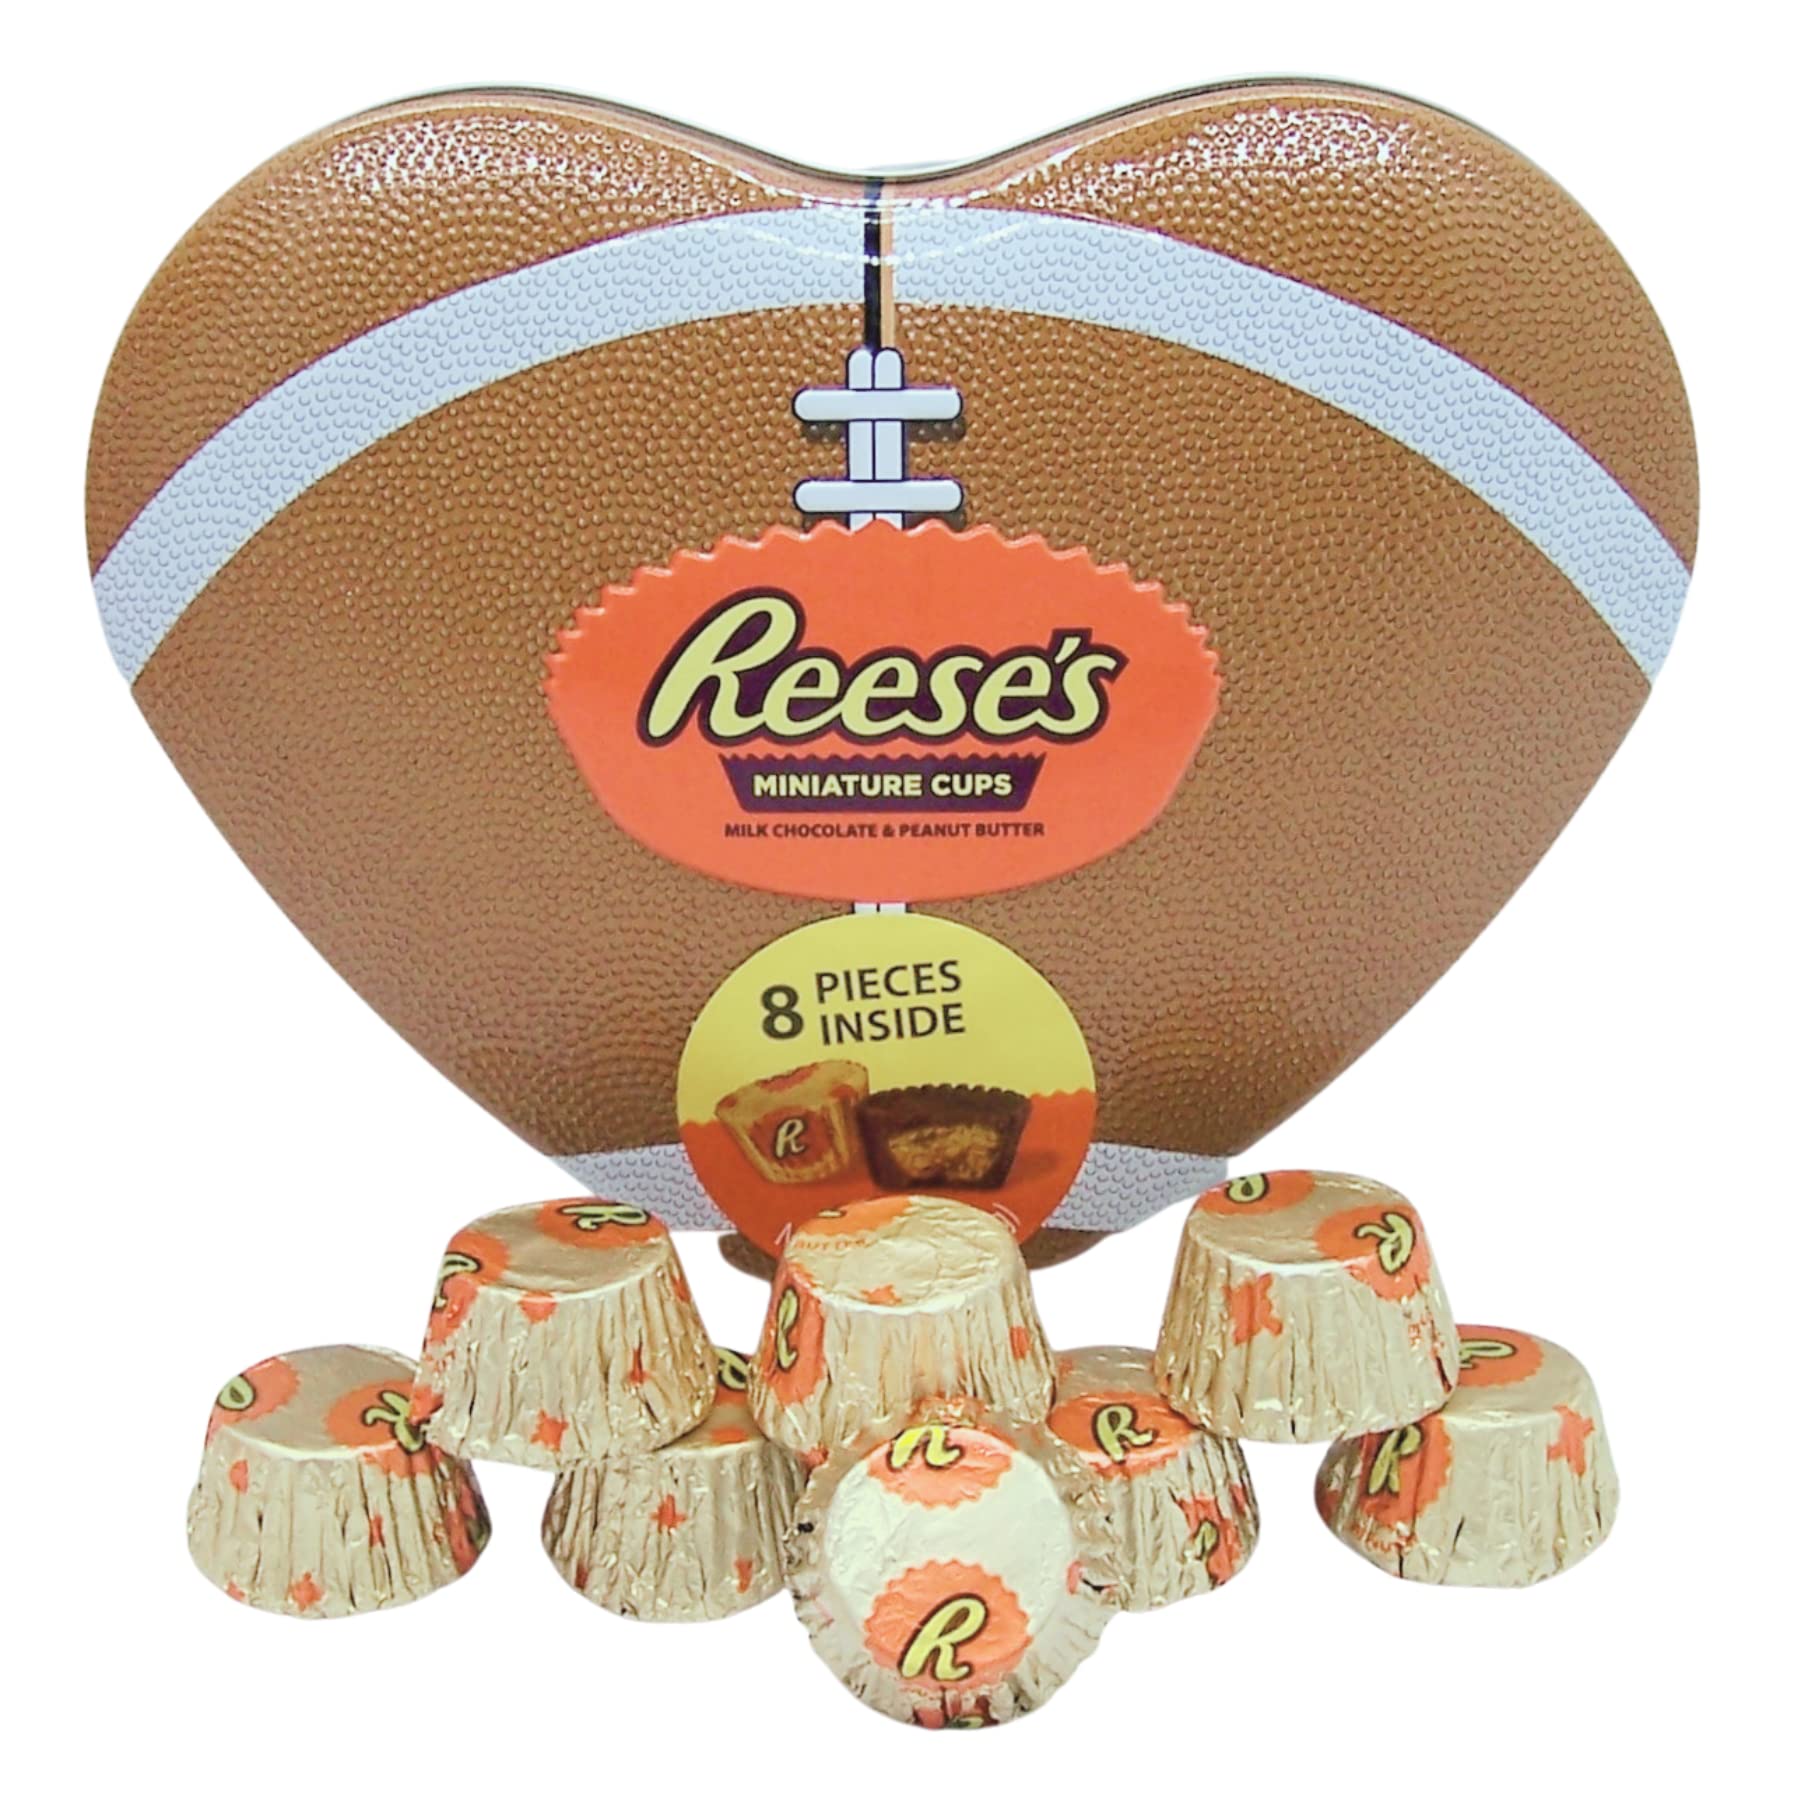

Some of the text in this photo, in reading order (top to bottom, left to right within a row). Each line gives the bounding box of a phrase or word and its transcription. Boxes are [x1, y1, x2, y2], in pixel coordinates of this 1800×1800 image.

[752, 772, 1013, 797] MINIATURE CUPS
[724, 822, 1045, 838] MILK CHOCOLATE & PEANUT BUTTER
[760, 960, 962, 1040] 8 PIECES
[819, 1002, 966, 1046] INSIDE
[772, 1117, 808, 1159] R
[1091, 1402, 1156, 1464] R
[897, 1592, 988, 1682] R
